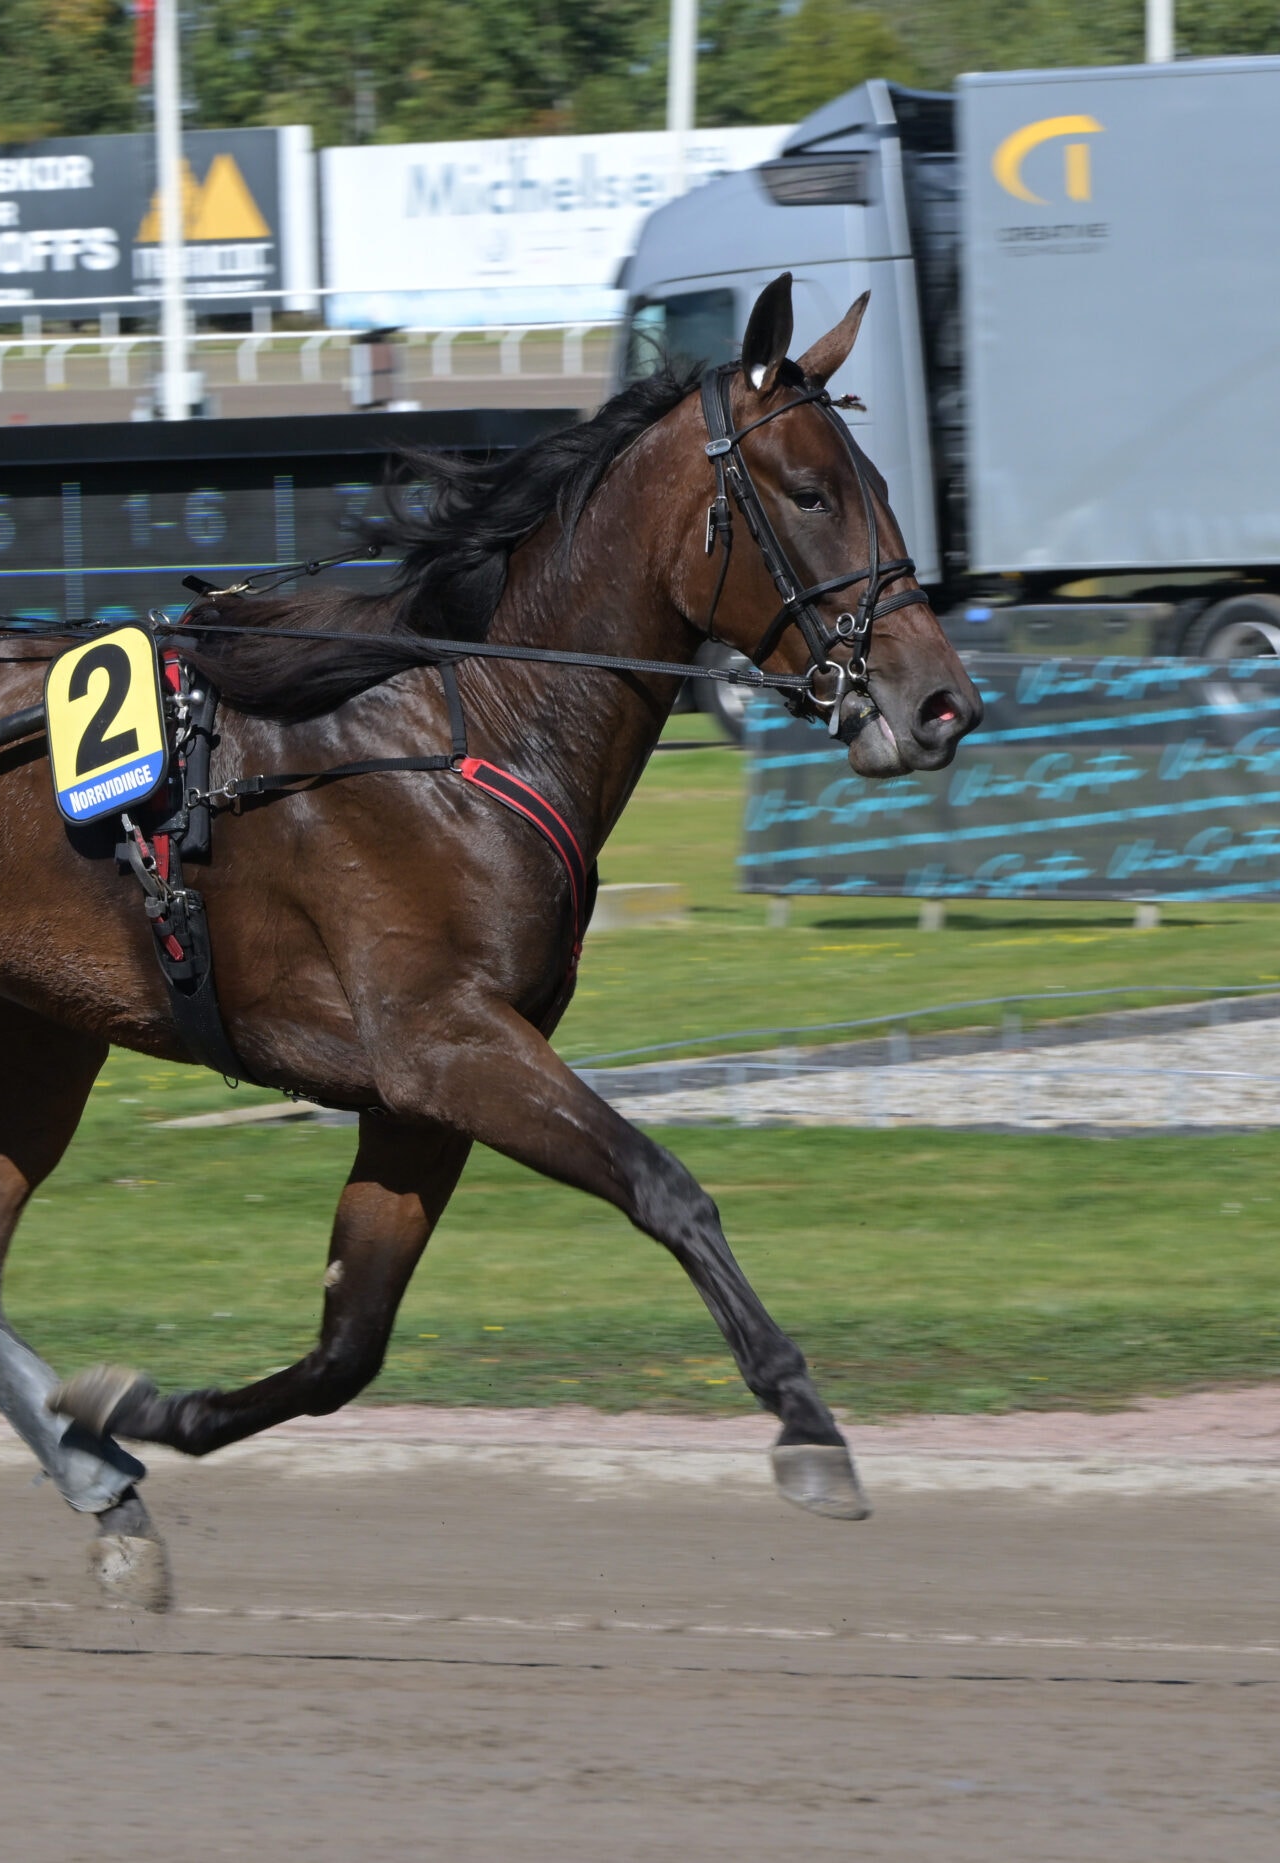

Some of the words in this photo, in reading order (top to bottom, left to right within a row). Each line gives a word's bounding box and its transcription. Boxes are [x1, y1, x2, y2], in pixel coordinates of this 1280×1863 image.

[123, 487, 228, 548] 1-6
[68, 643, 140, 777] 2
[69, 764, 154, 814] NORRVIDINGE
